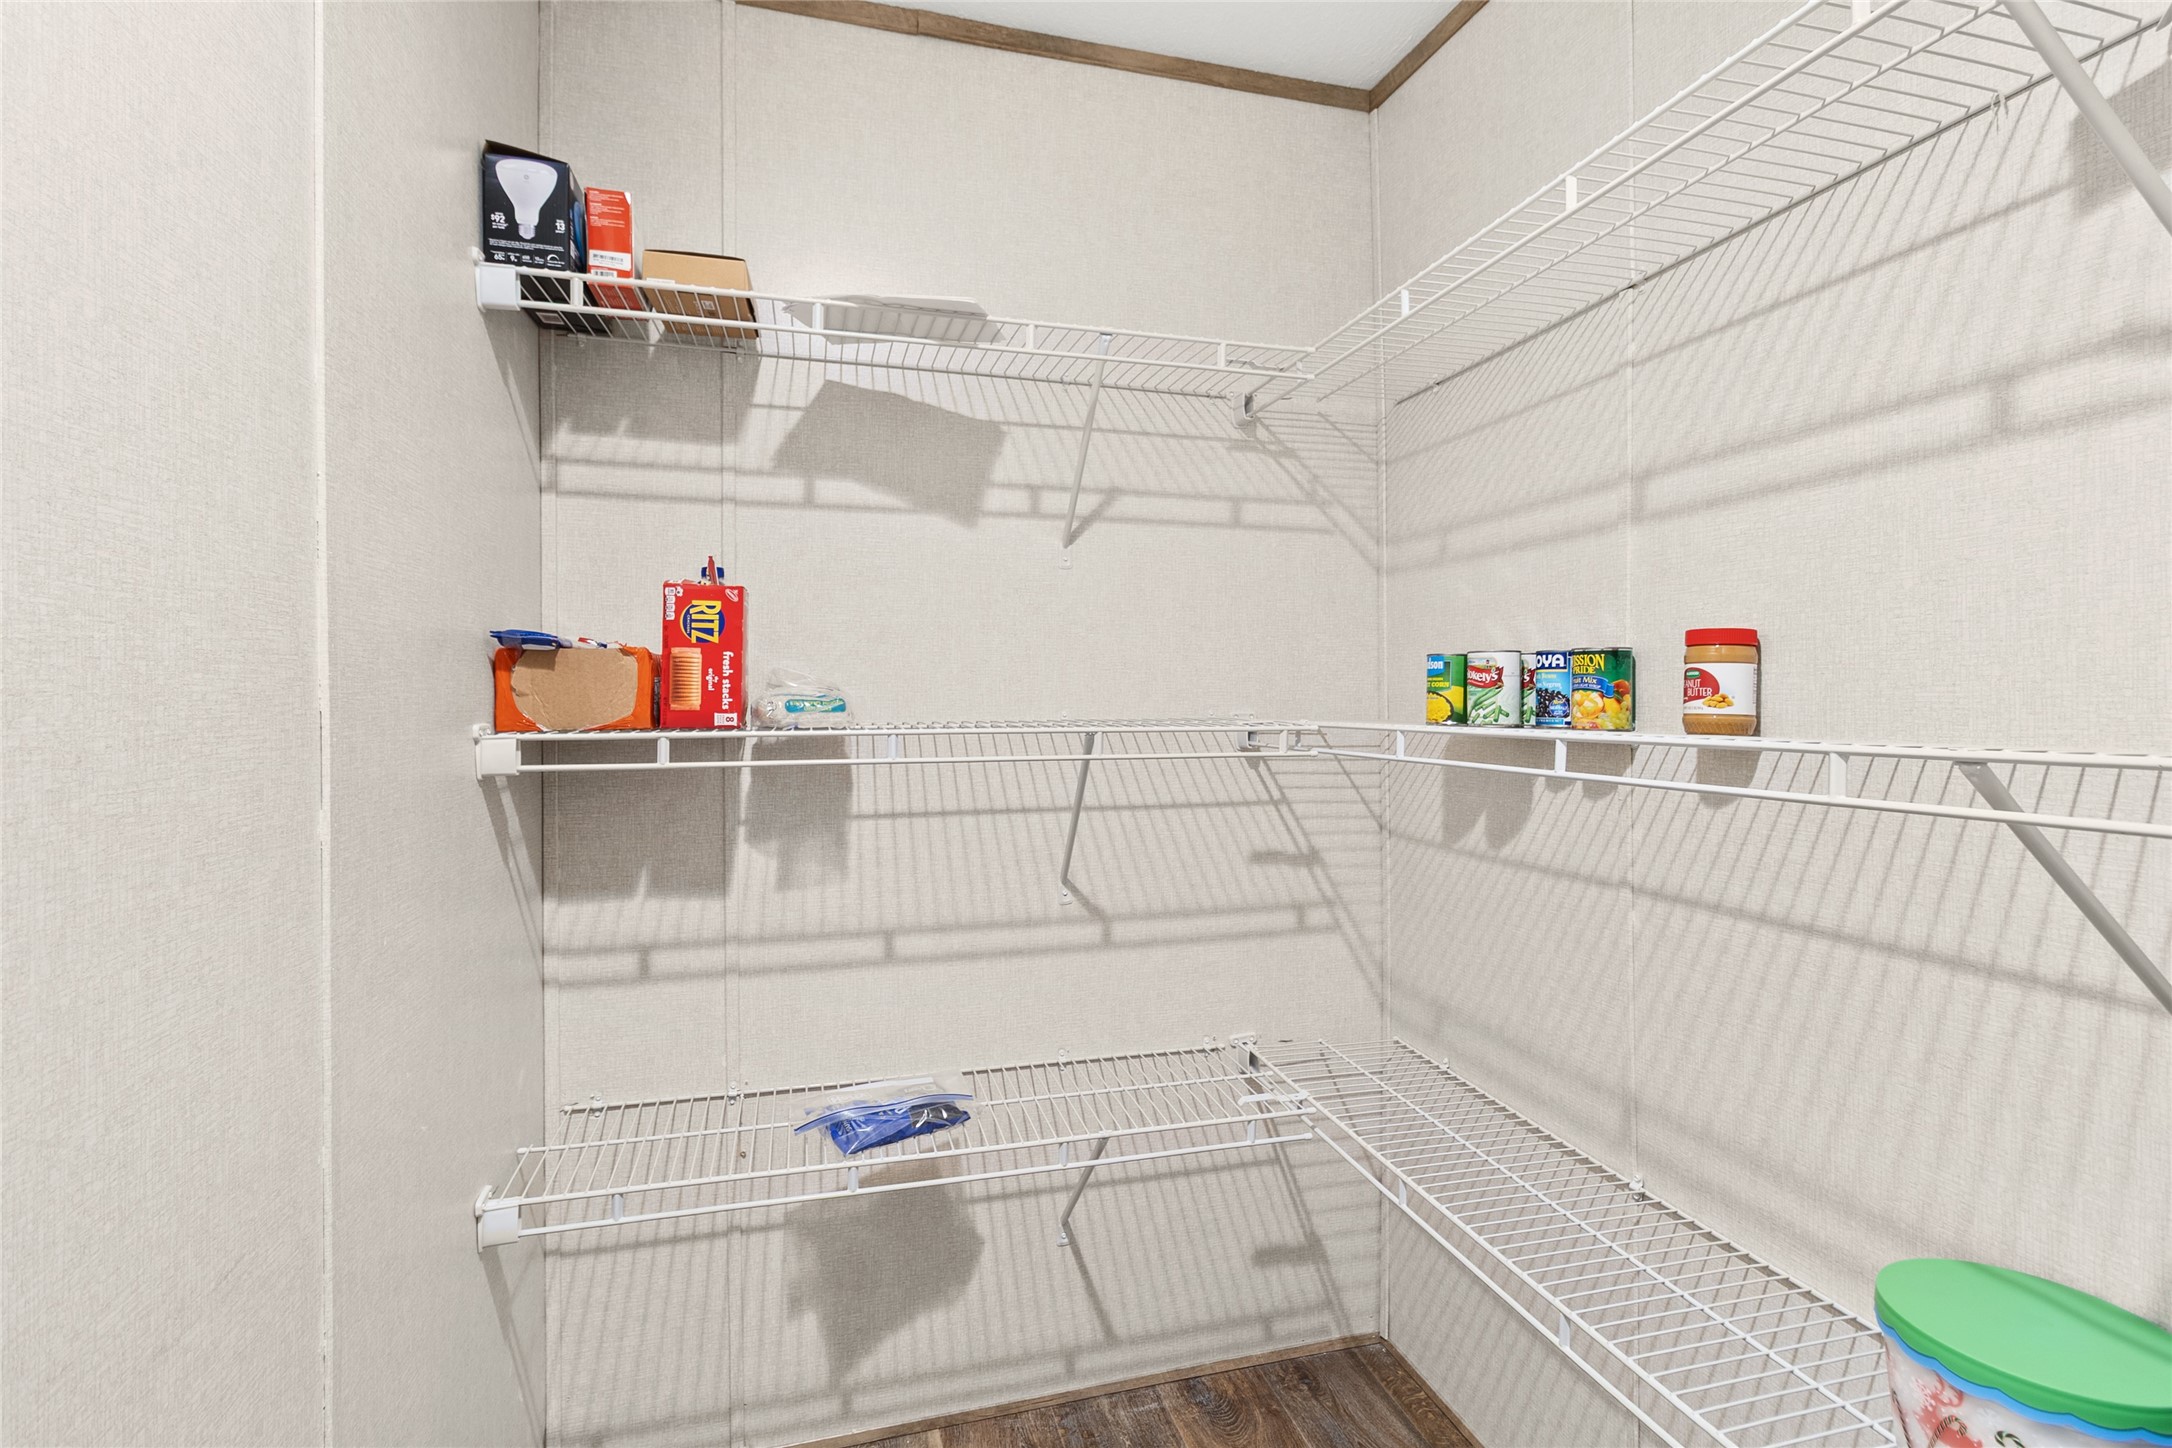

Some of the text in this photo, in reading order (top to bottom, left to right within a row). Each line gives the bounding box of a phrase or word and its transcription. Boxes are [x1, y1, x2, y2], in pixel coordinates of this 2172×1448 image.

[555, 222, 566, 231] 13
[690, 600, 722, 643] RITZ
[705, 667, 715, 691] original
[722, 651, 734, 710] fresh stacks
[1687, 687, 1713, 697] BUTTER
